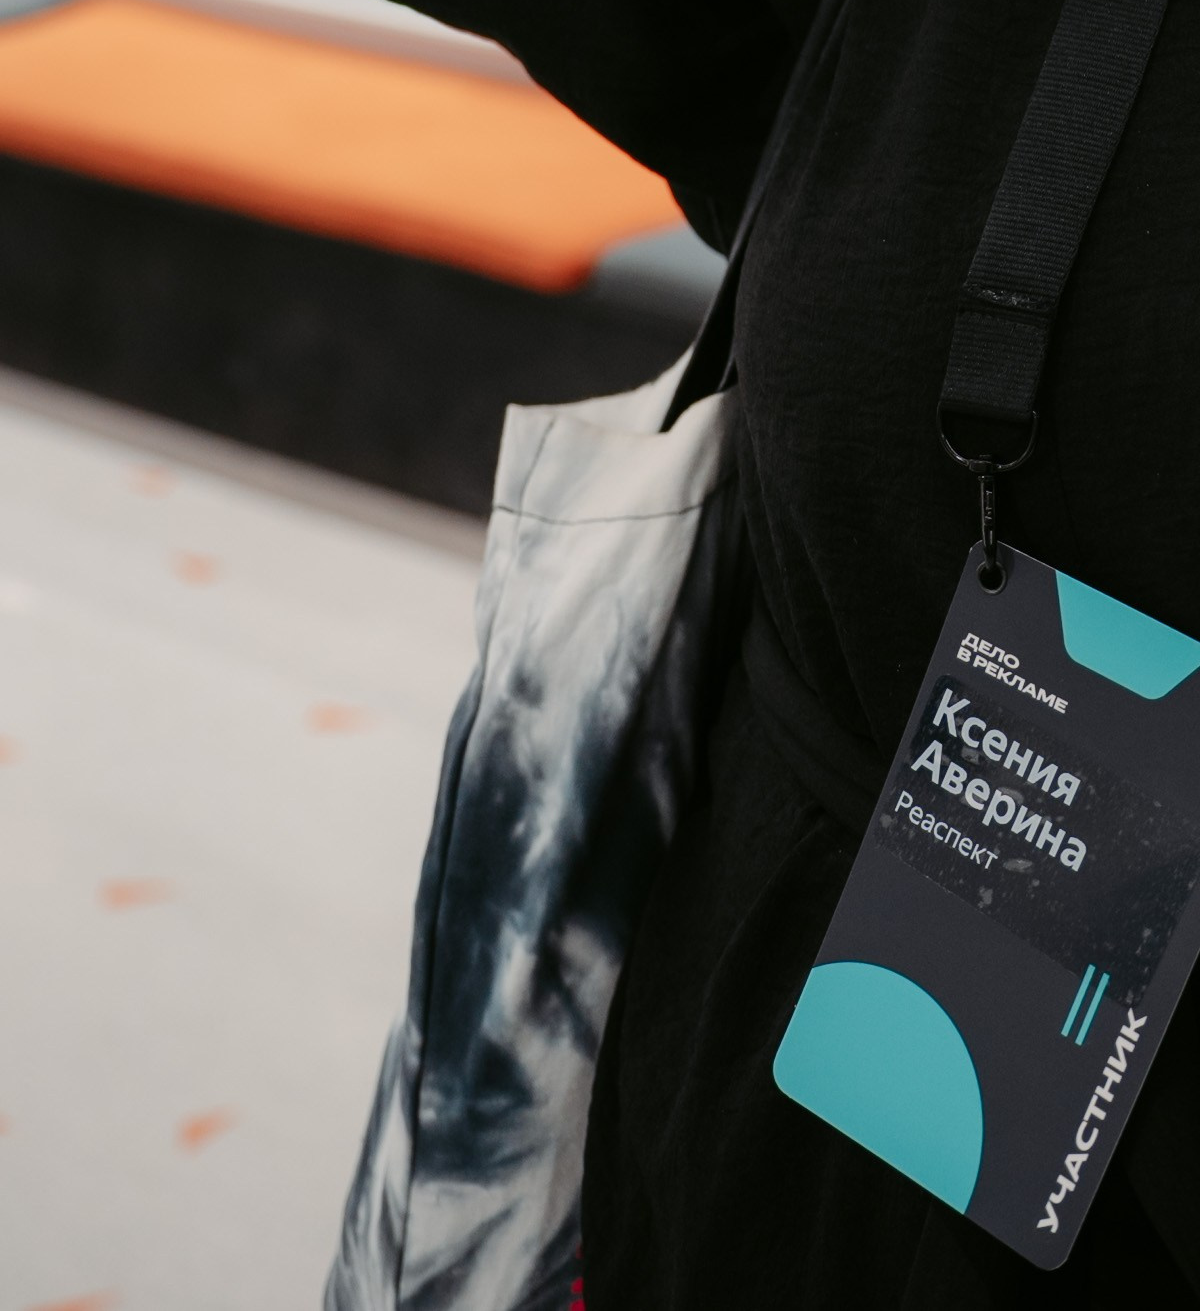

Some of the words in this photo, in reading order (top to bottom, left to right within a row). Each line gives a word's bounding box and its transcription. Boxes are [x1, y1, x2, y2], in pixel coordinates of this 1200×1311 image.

[956, 646, 972, 663] В
[972, 654, 1069, 714] РЕКЛАМЕ
[960, 632, 1020, 669] ДЕЛО
[932, 687, 1081, 807] Ксения
[894, 790, 999, 870] Реаспект
[910, 739, 1087, 872] Аверина
[1036, 1007, 1148, 1234] УЧАСТНИК
